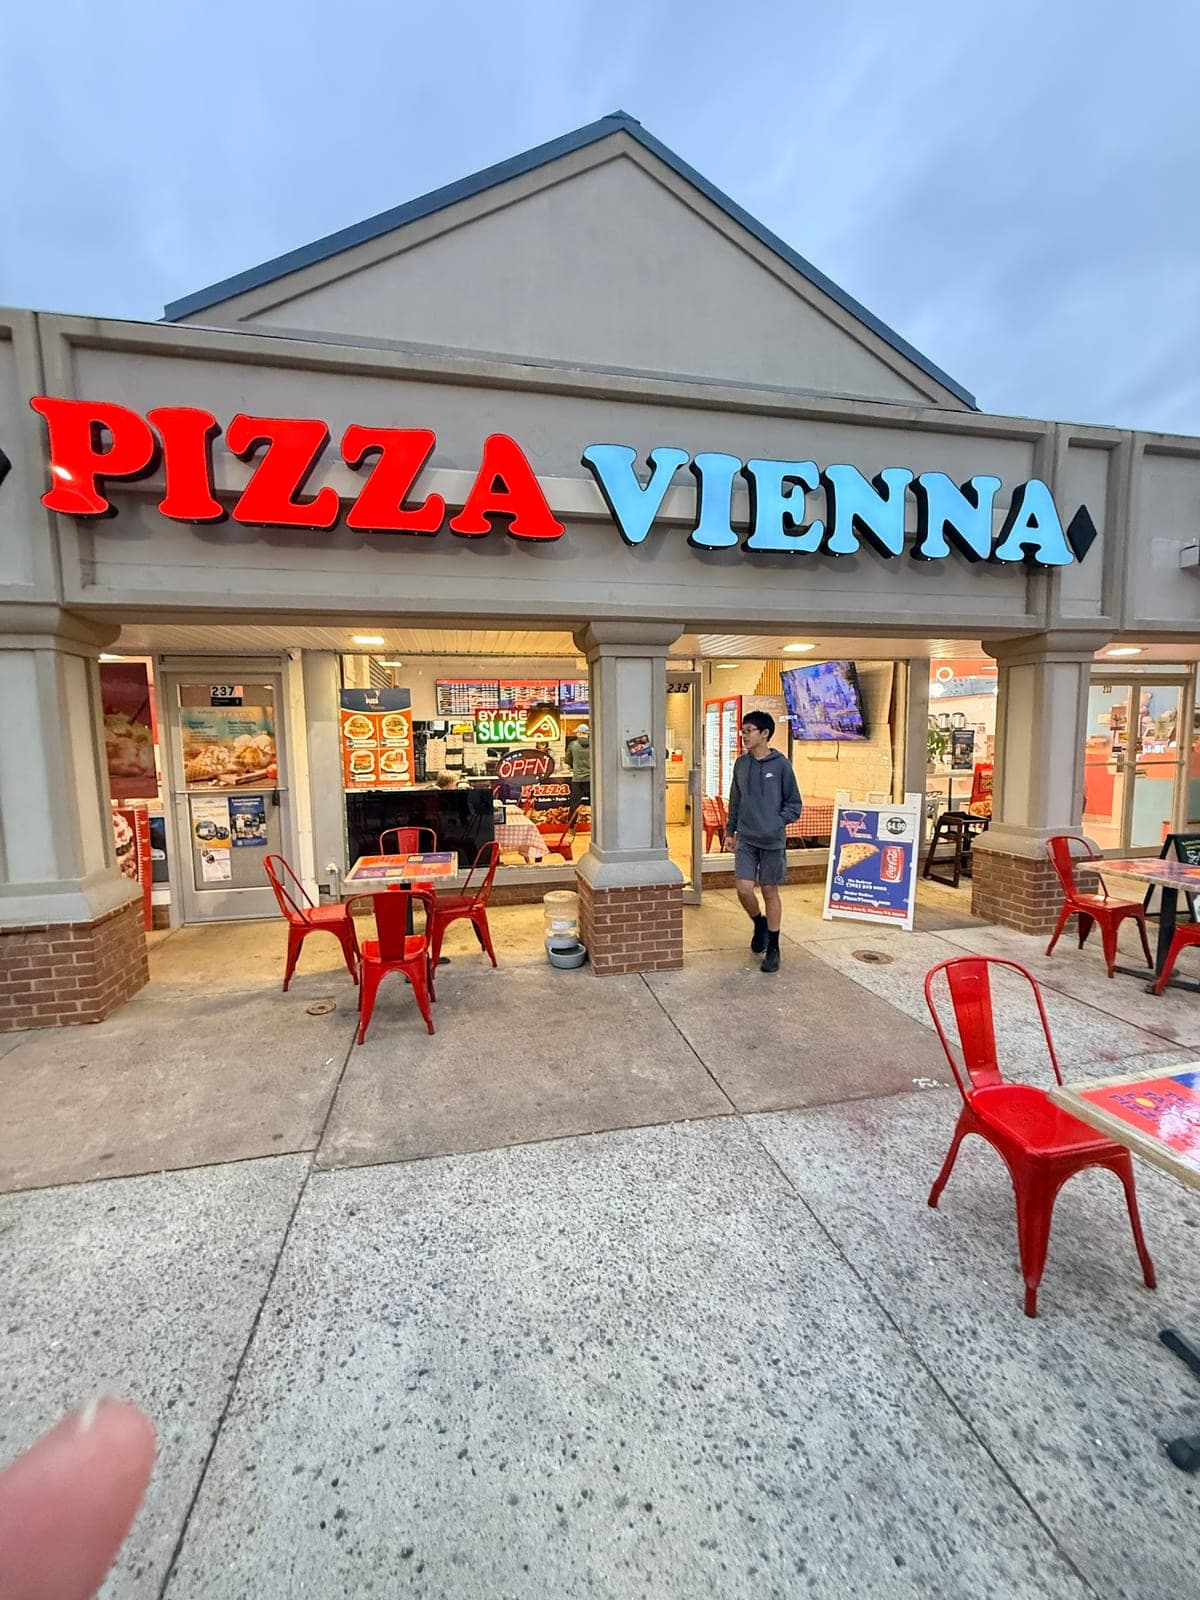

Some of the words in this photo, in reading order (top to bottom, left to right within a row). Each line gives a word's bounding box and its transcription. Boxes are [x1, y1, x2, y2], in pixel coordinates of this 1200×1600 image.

[31, 396, 566, 540] PIZZA
[582, 443, 1074, 567] VIENNA
[211, 686, 235, 697] 237
[666, 682, 691, 694] 235
[478, 709, 498, 721] BY
[499, 709, 528, 721] THE
[478, 721, 528, 741] SLICE
[886, 821, 906, 832] $4.99
